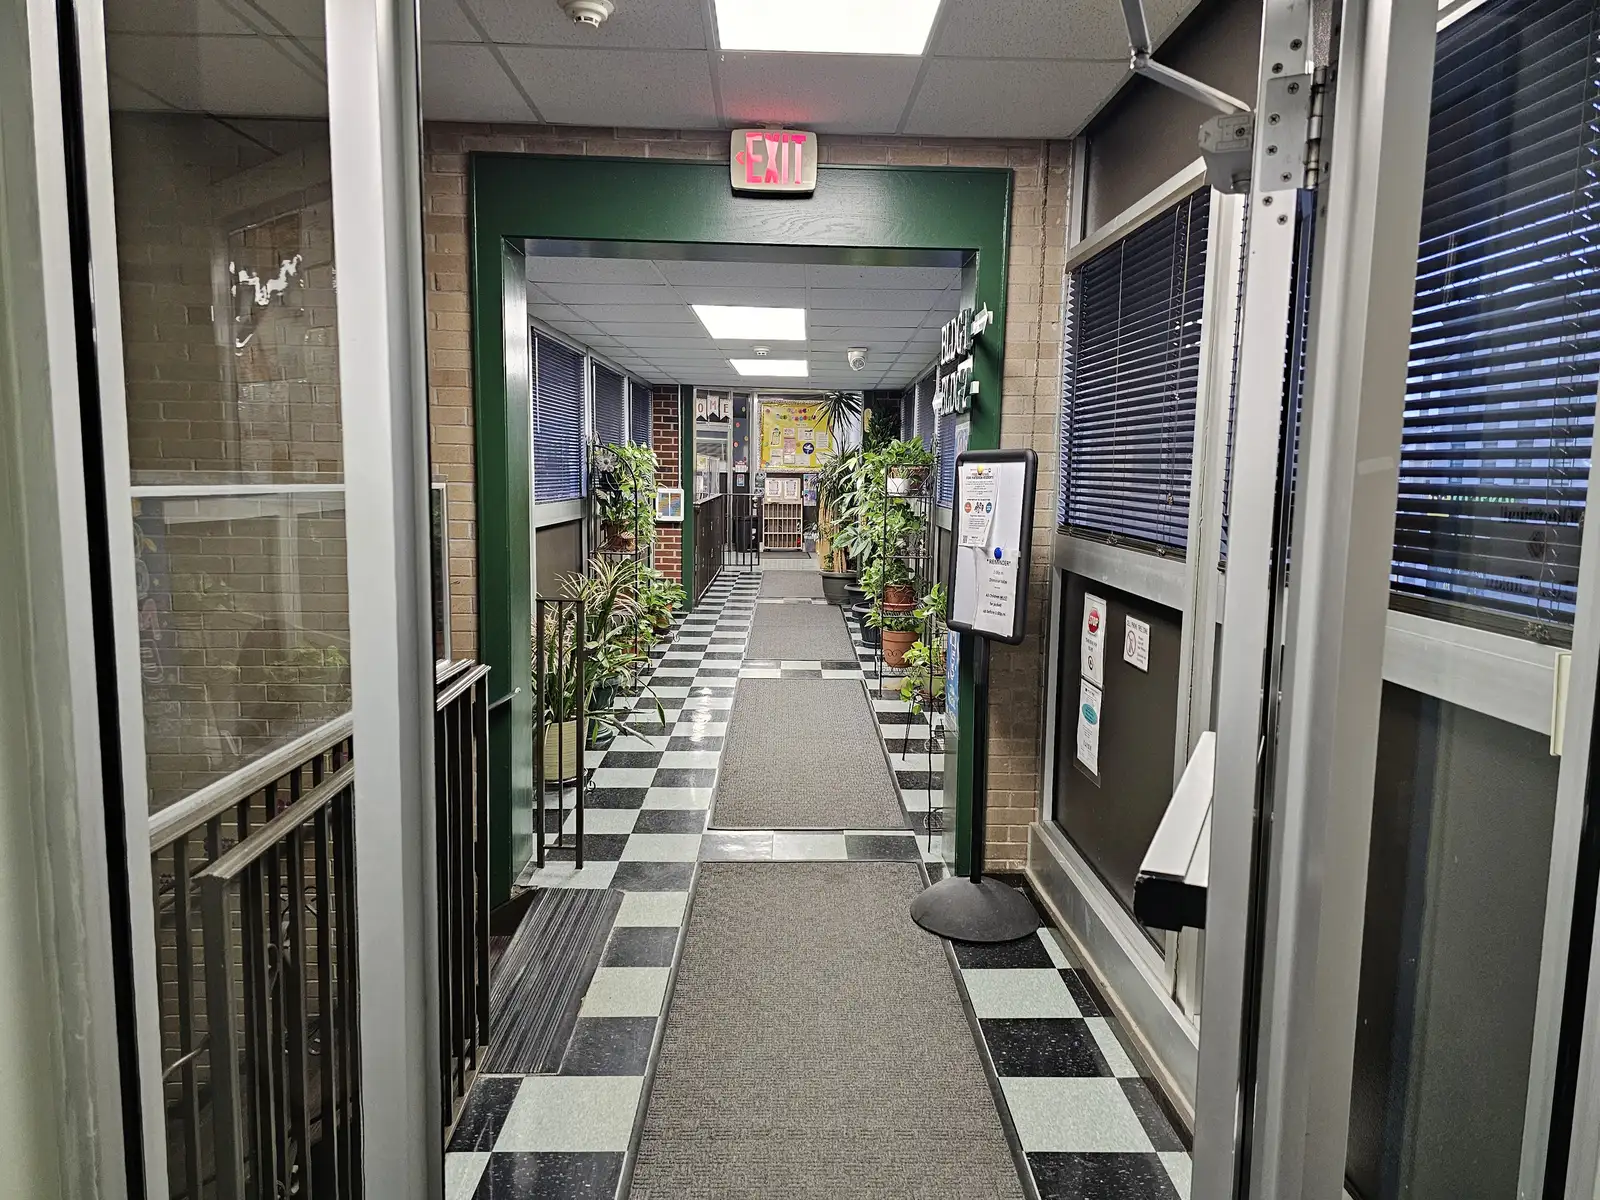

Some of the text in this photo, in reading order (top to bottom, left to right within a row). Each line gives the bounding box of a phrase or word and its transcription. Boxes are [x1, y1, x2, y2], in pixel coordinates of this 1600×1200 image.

[745, 132, 807, 185] EXIT
[941, 311, 964, 366] BLDG
[941, 371, 961, 416] BLDG
[1088, 614, 1099, 626] STOP
